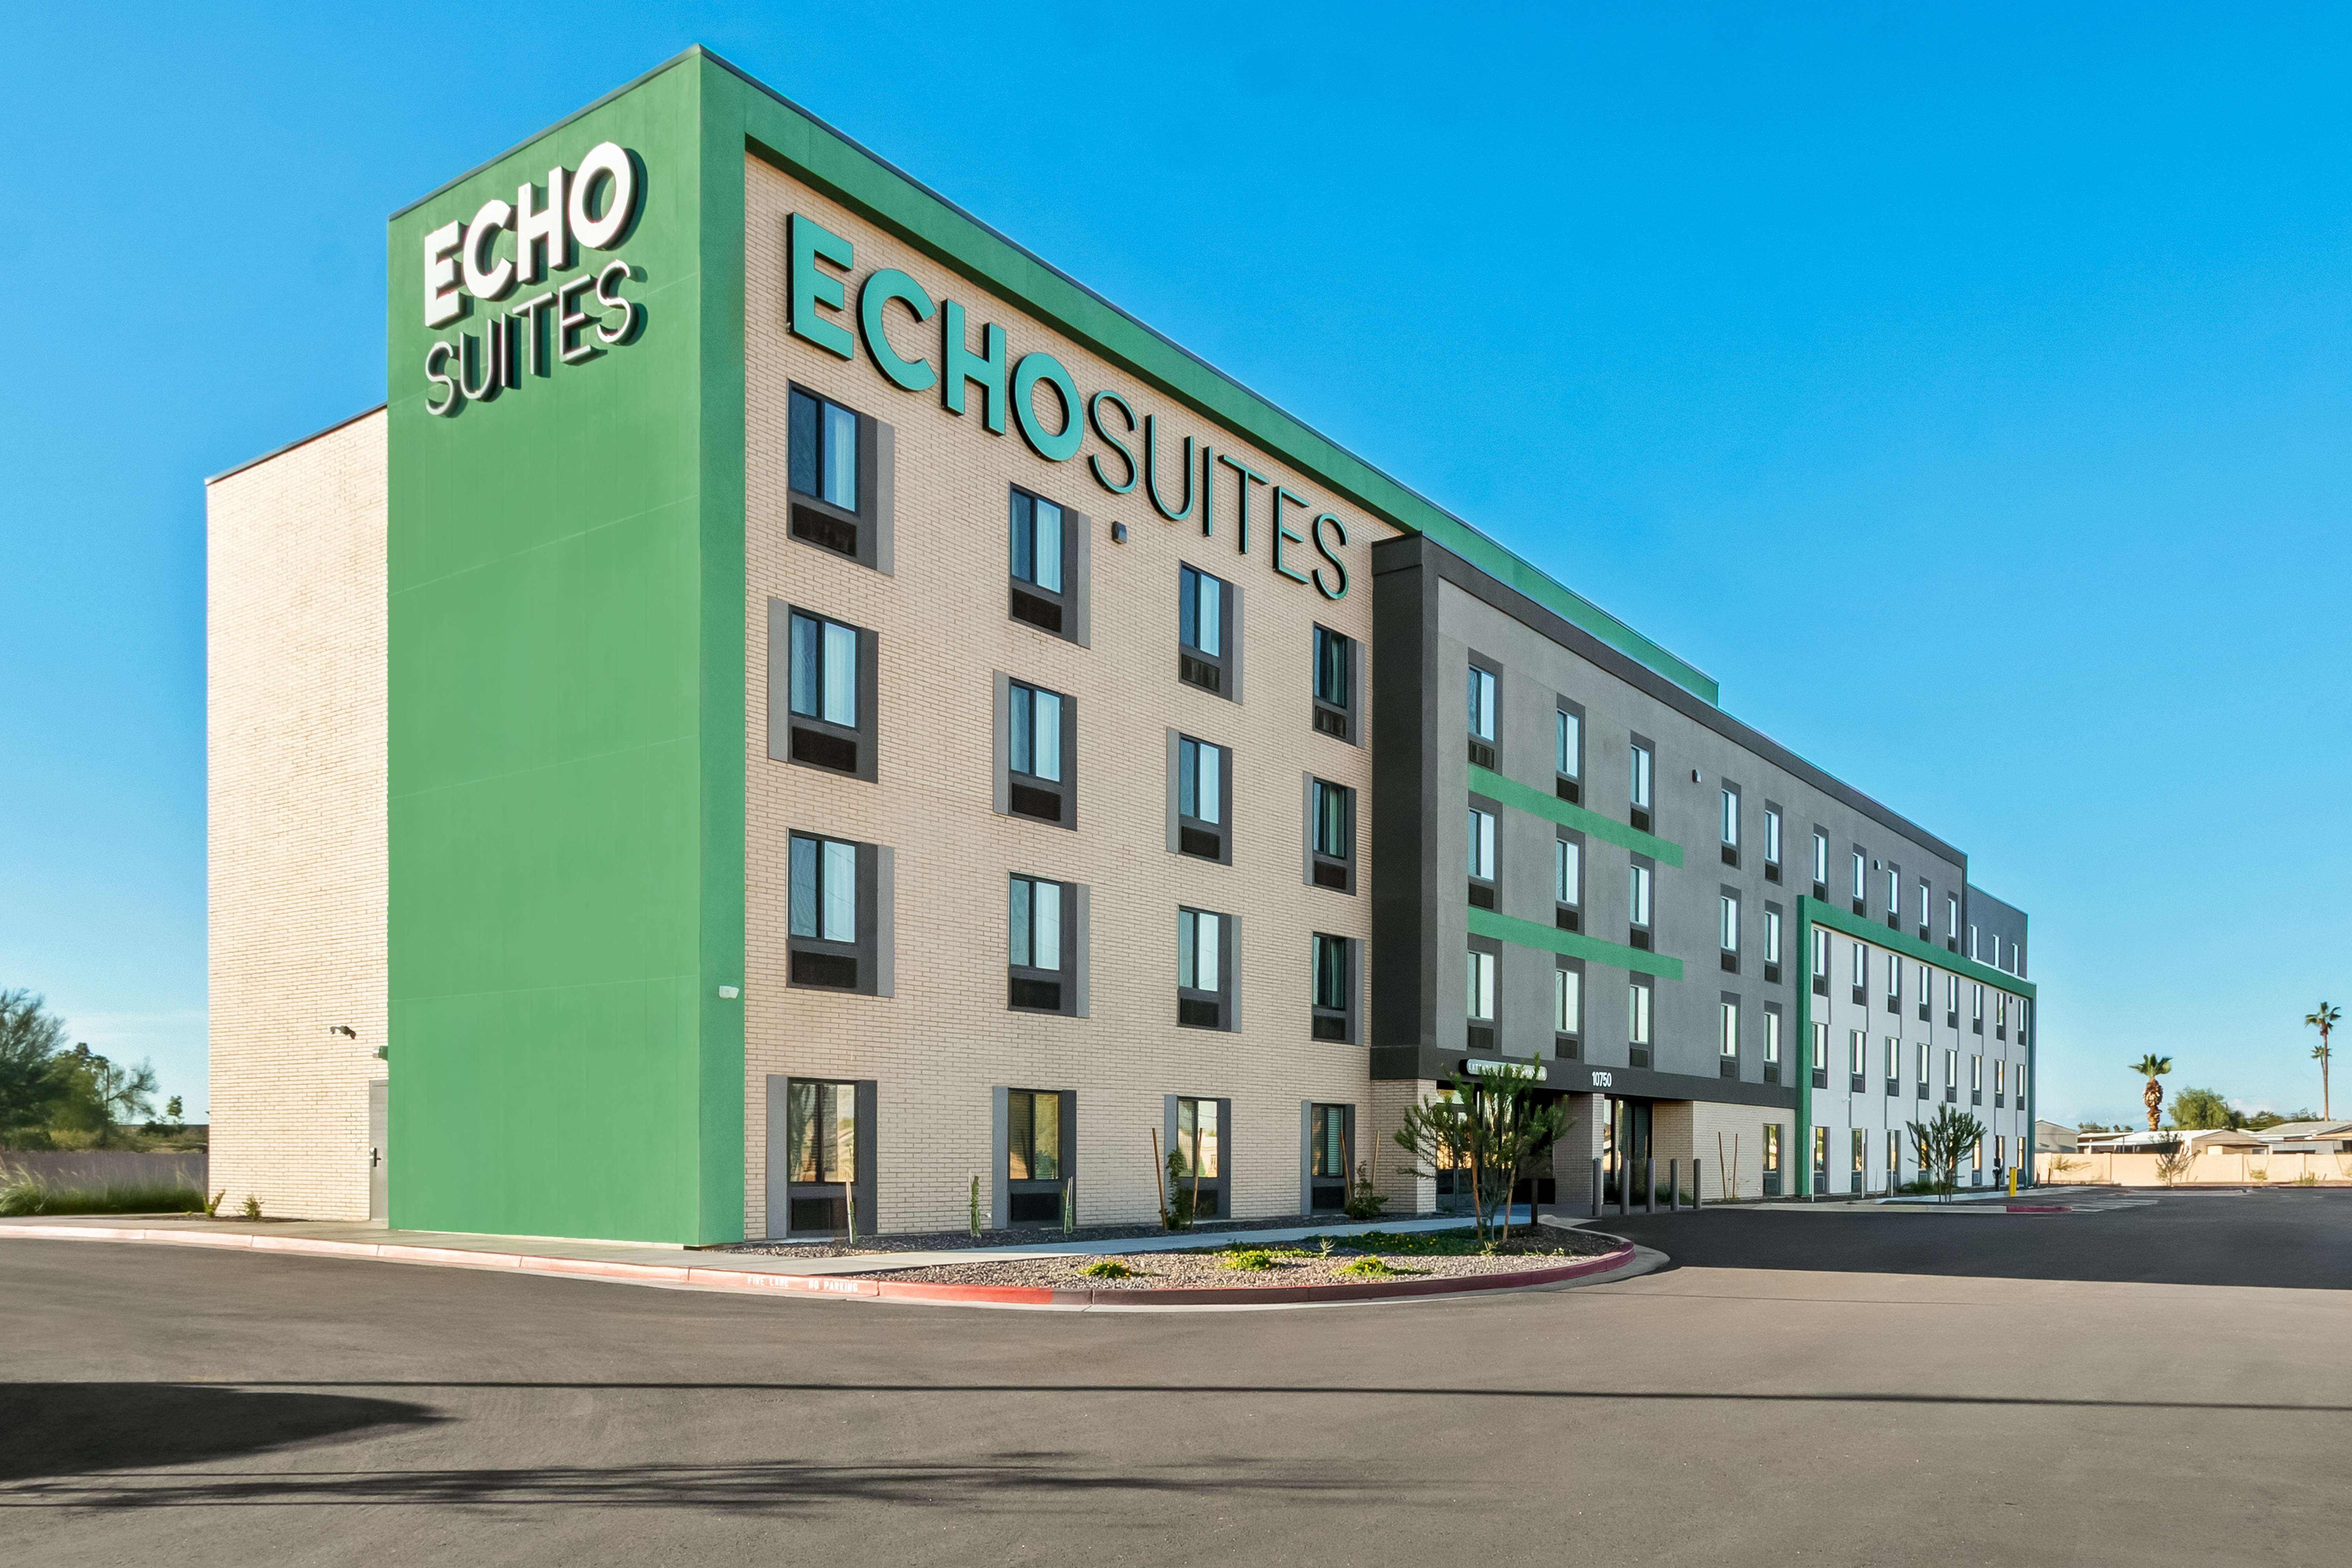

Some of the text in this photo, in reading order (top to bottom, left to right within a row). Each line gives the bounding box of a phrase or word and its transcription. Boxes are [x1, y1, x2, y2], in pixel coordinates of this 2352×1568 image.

[424, 141, 632, 328] ECHO
[425, 259, 633, 416] SUITES
[1592, 1071, 1612, 1087] 10750
[747, 1276, 858, 1292] FIRE LANE NO PARKING
